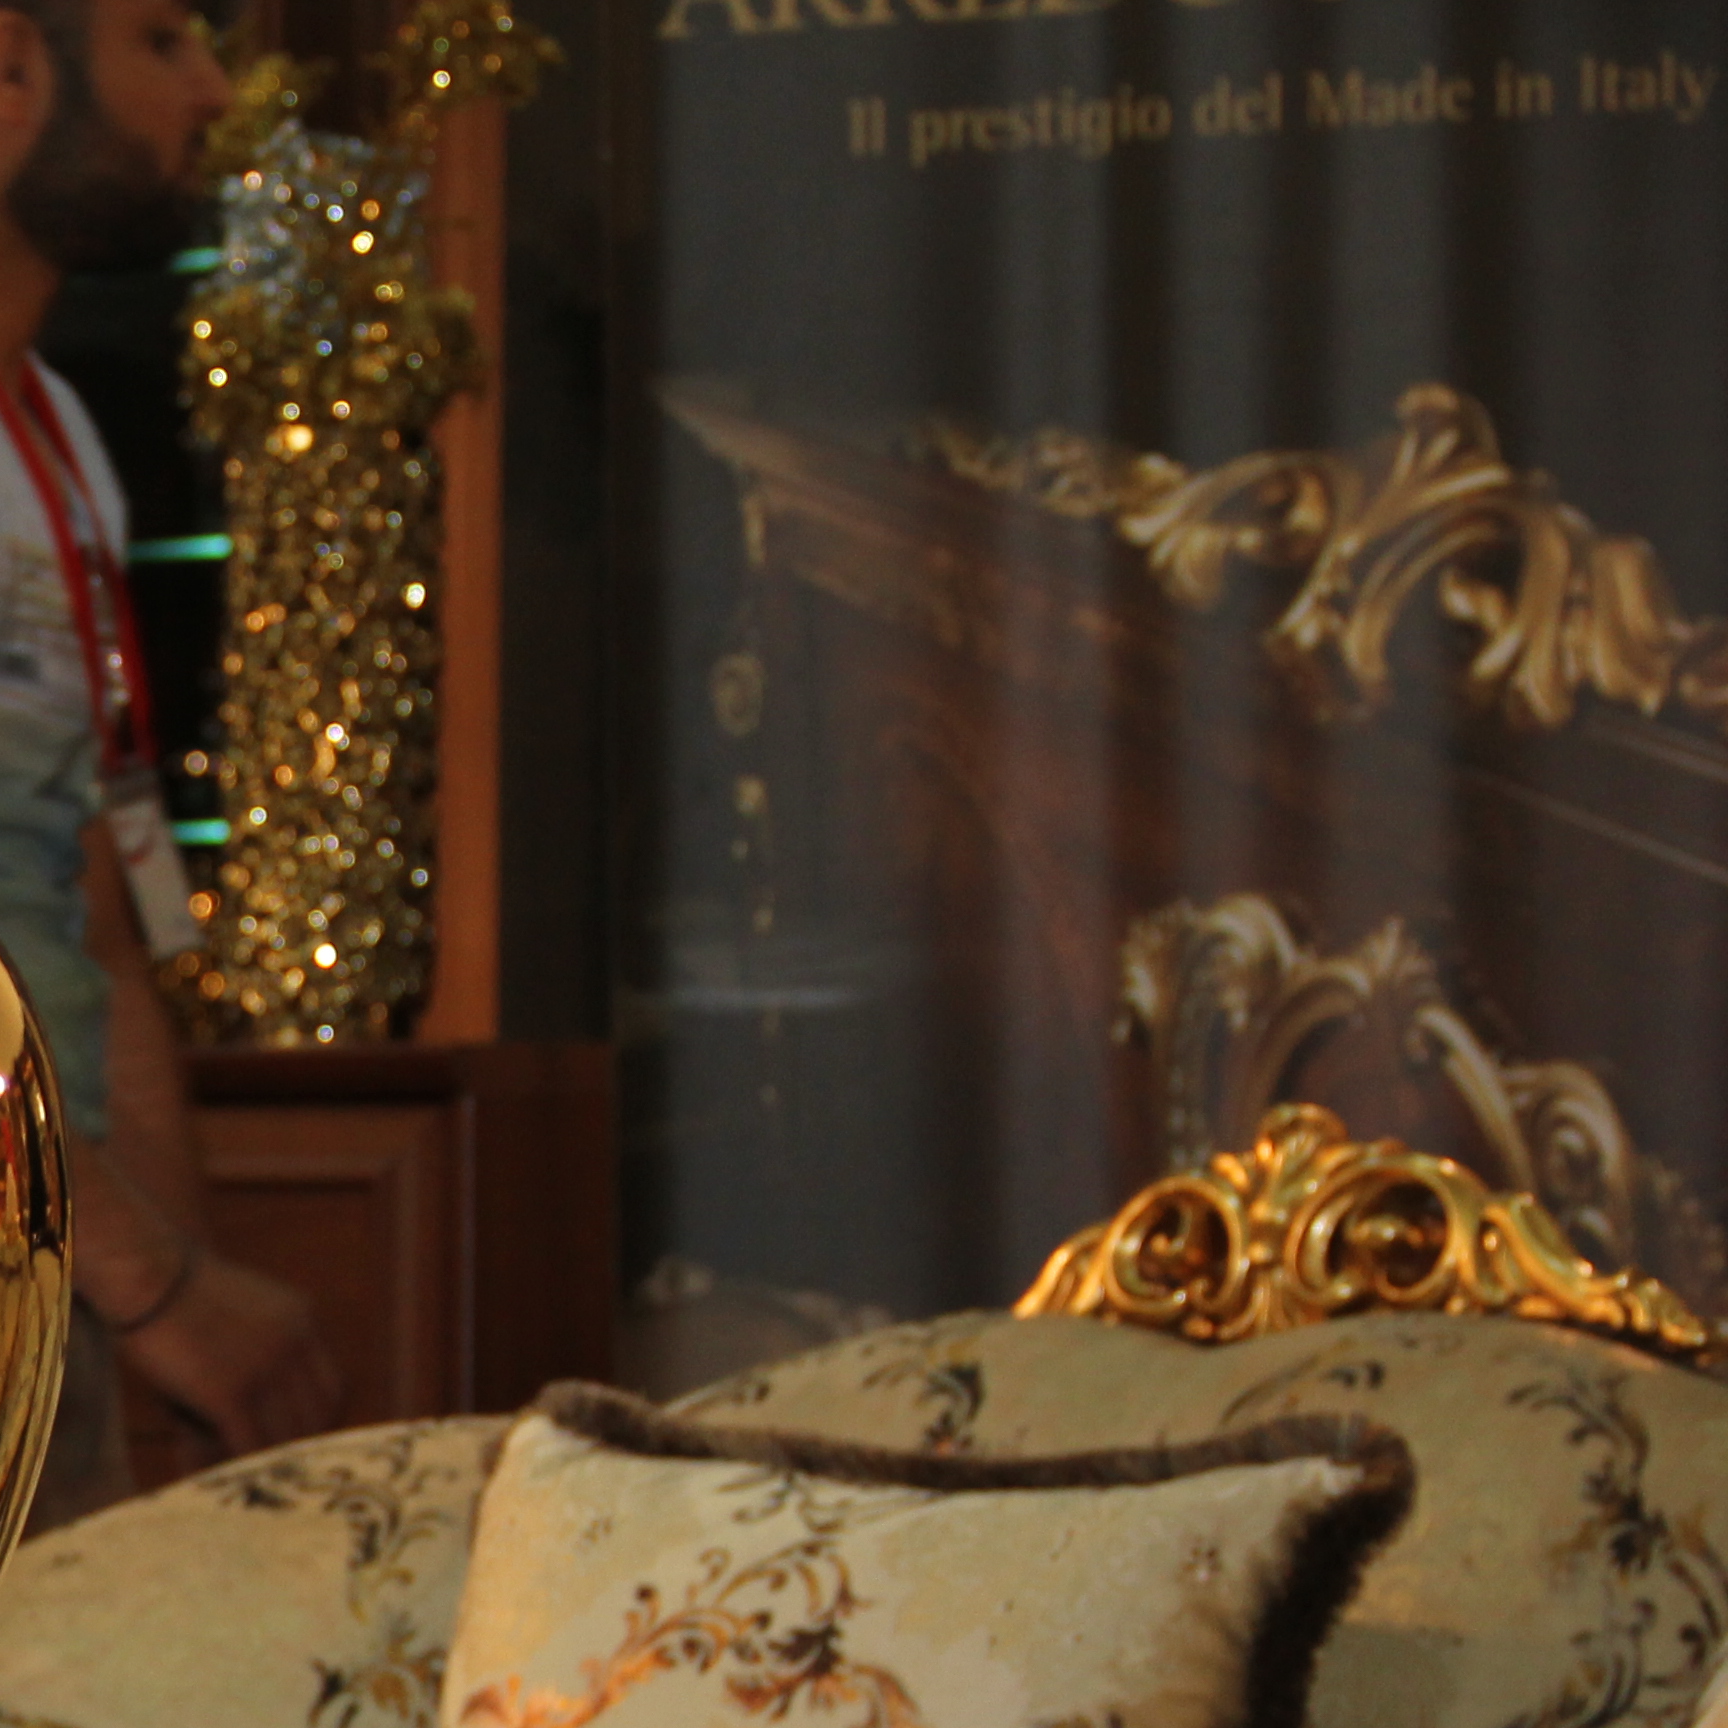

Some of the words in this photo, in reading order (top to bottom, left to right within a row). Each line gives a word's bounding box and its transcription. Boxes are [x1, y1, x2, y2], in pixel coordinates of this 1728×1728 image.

[908, 82, 1174, 169] prestigio
[1191, 71, 1284, 138] del
[1306, 60, 1474, 129] Made
[1495, 56, 1554, 120] in
[1580, 48, 1720, 124] Italy
